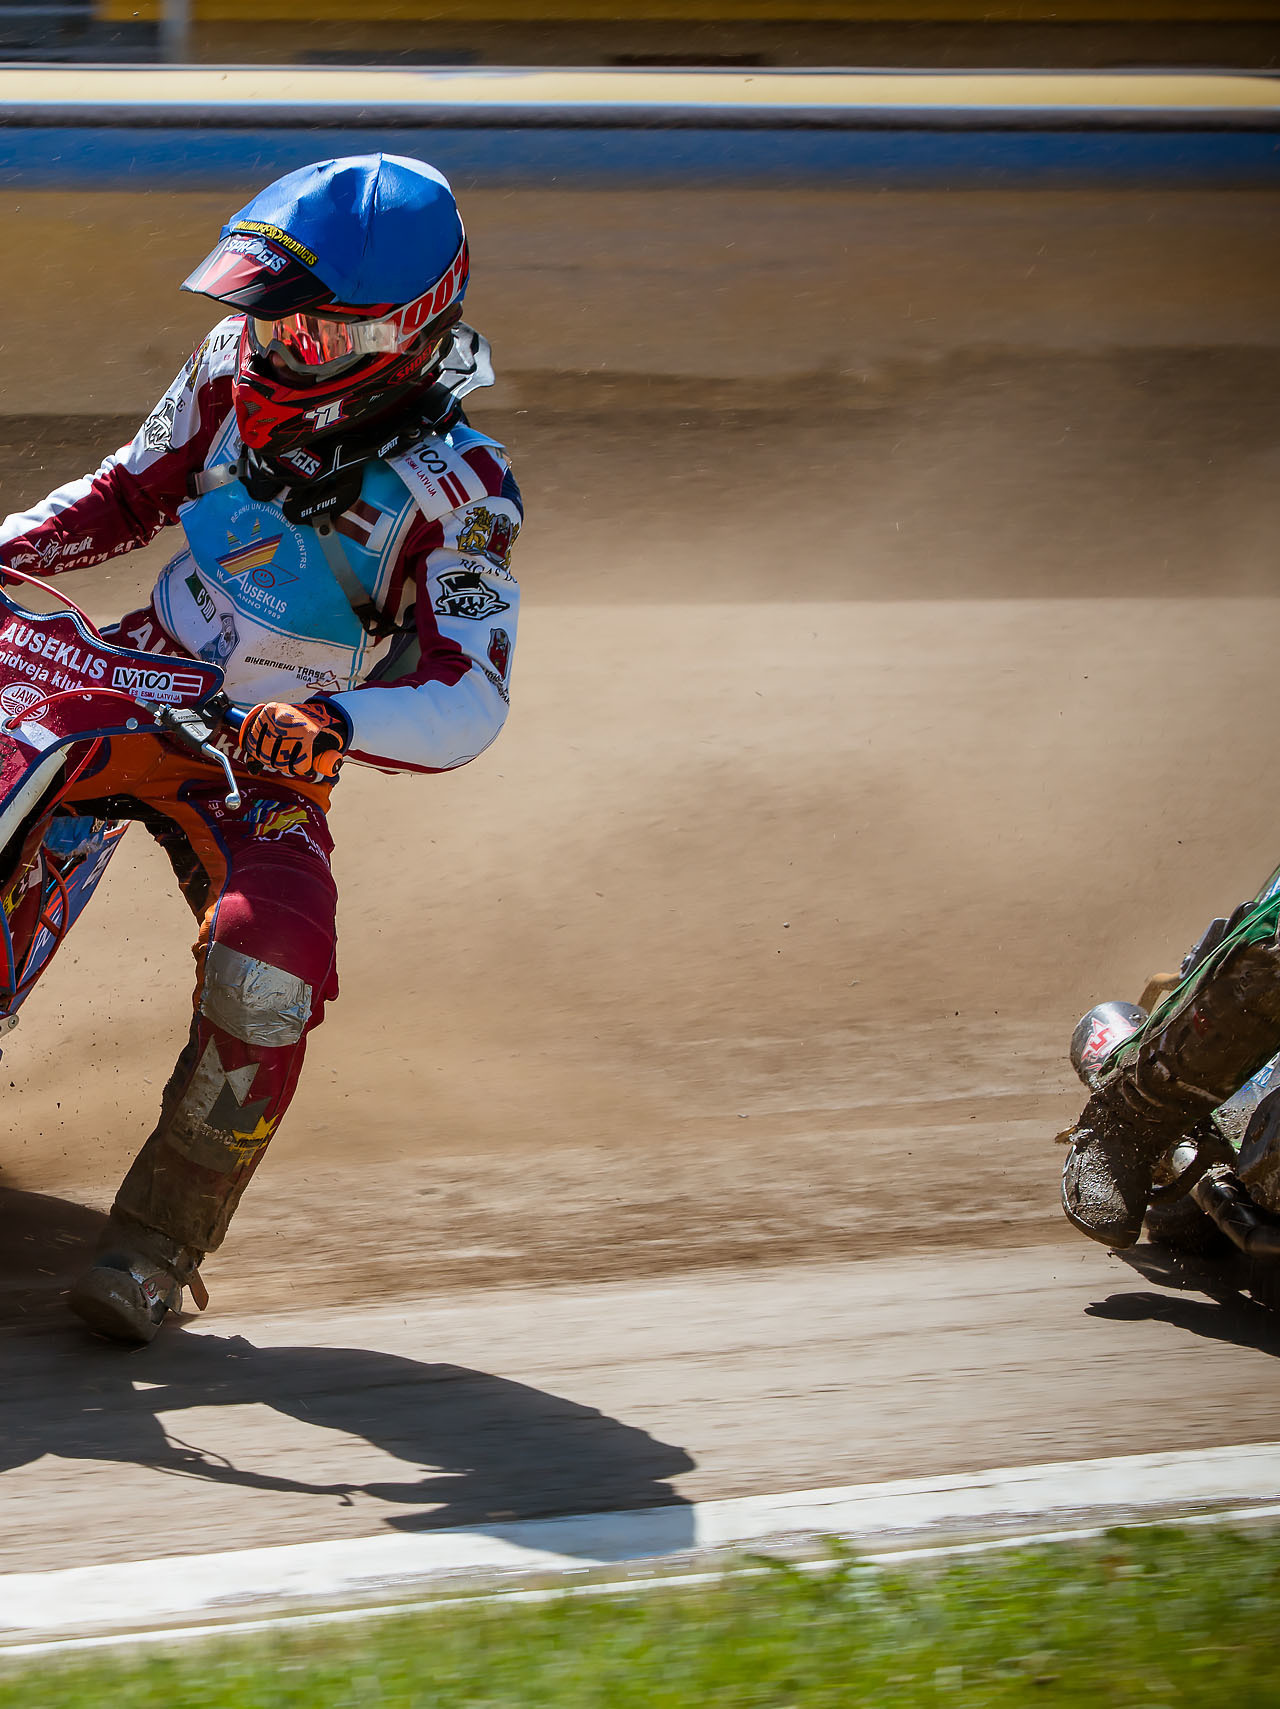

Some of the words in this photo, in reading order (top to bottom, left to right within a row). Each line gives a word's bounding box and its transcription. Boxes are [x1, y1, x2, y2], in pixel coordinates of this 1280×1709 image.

[279, 233, 318, 266] PRODUCTS
[416, 470, 437, 497] LATVIJA
[294, 532, 307, 569] CENTRS
[197, 588, 216, 621] CSDD
[223, 571, 288, 613] AUSEKLIS
[237, 593, 261, 609] ANNO
[0, 622, 108, 680] AUSEKLIS
[141, 690, 156, 699] ESMU
[157, 692, 180, 701] LATVIJA
